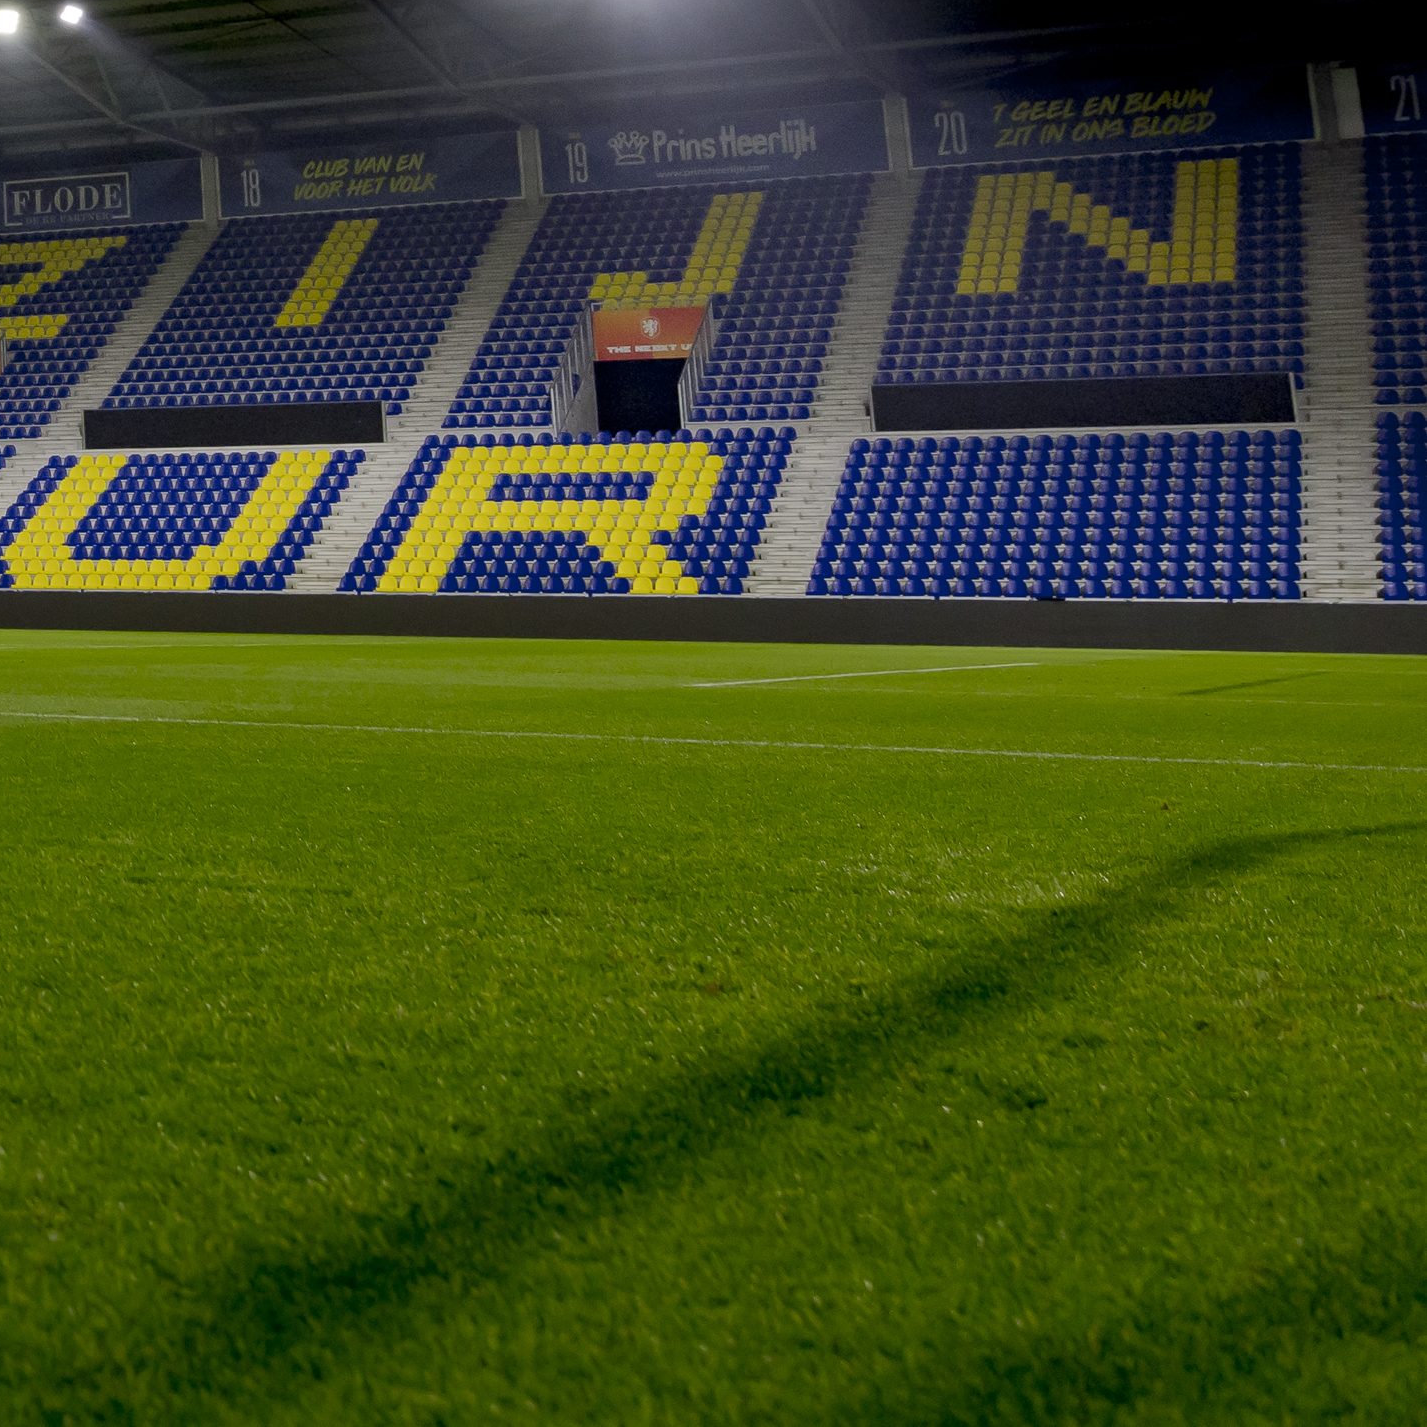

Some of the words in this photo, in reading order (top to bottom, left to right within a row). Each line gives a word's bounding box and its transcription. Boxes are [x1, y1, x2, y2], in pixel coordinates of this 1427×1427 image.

[1010, 98, 1076, 122] GEEL
[1082, 95, 1120, 117] EN
[1123, 88, 1214, 114] BLAUW
[1389, 75, 1421, 121] 21
[652, 128, 717, 163] Prins
[719, 119, 817, 160] Heerlijk
[933, 110, 969, 156] 20
[994, 124, 1037, 148] ZIT
[1039, 122, 1067, 145] IN
[1072, 118, 1124, 142] ONS
[1130, 112, 1216, 138] BLOED
[302, 158, 350, 179] CLUB
[353, 154, 393, 175] VAN
[395, 152, 426, 172] EN
[565, 142, 589, 184] 19
[12, 183, 122, 216] FLODE
[240, 169, 261, 207] 18
[294, 179, 345, 200] VOOR
[346, 176, 387, 197] HET
[388, 173, 438, 193] VOLK
[606, 345, 632, 354] THE
